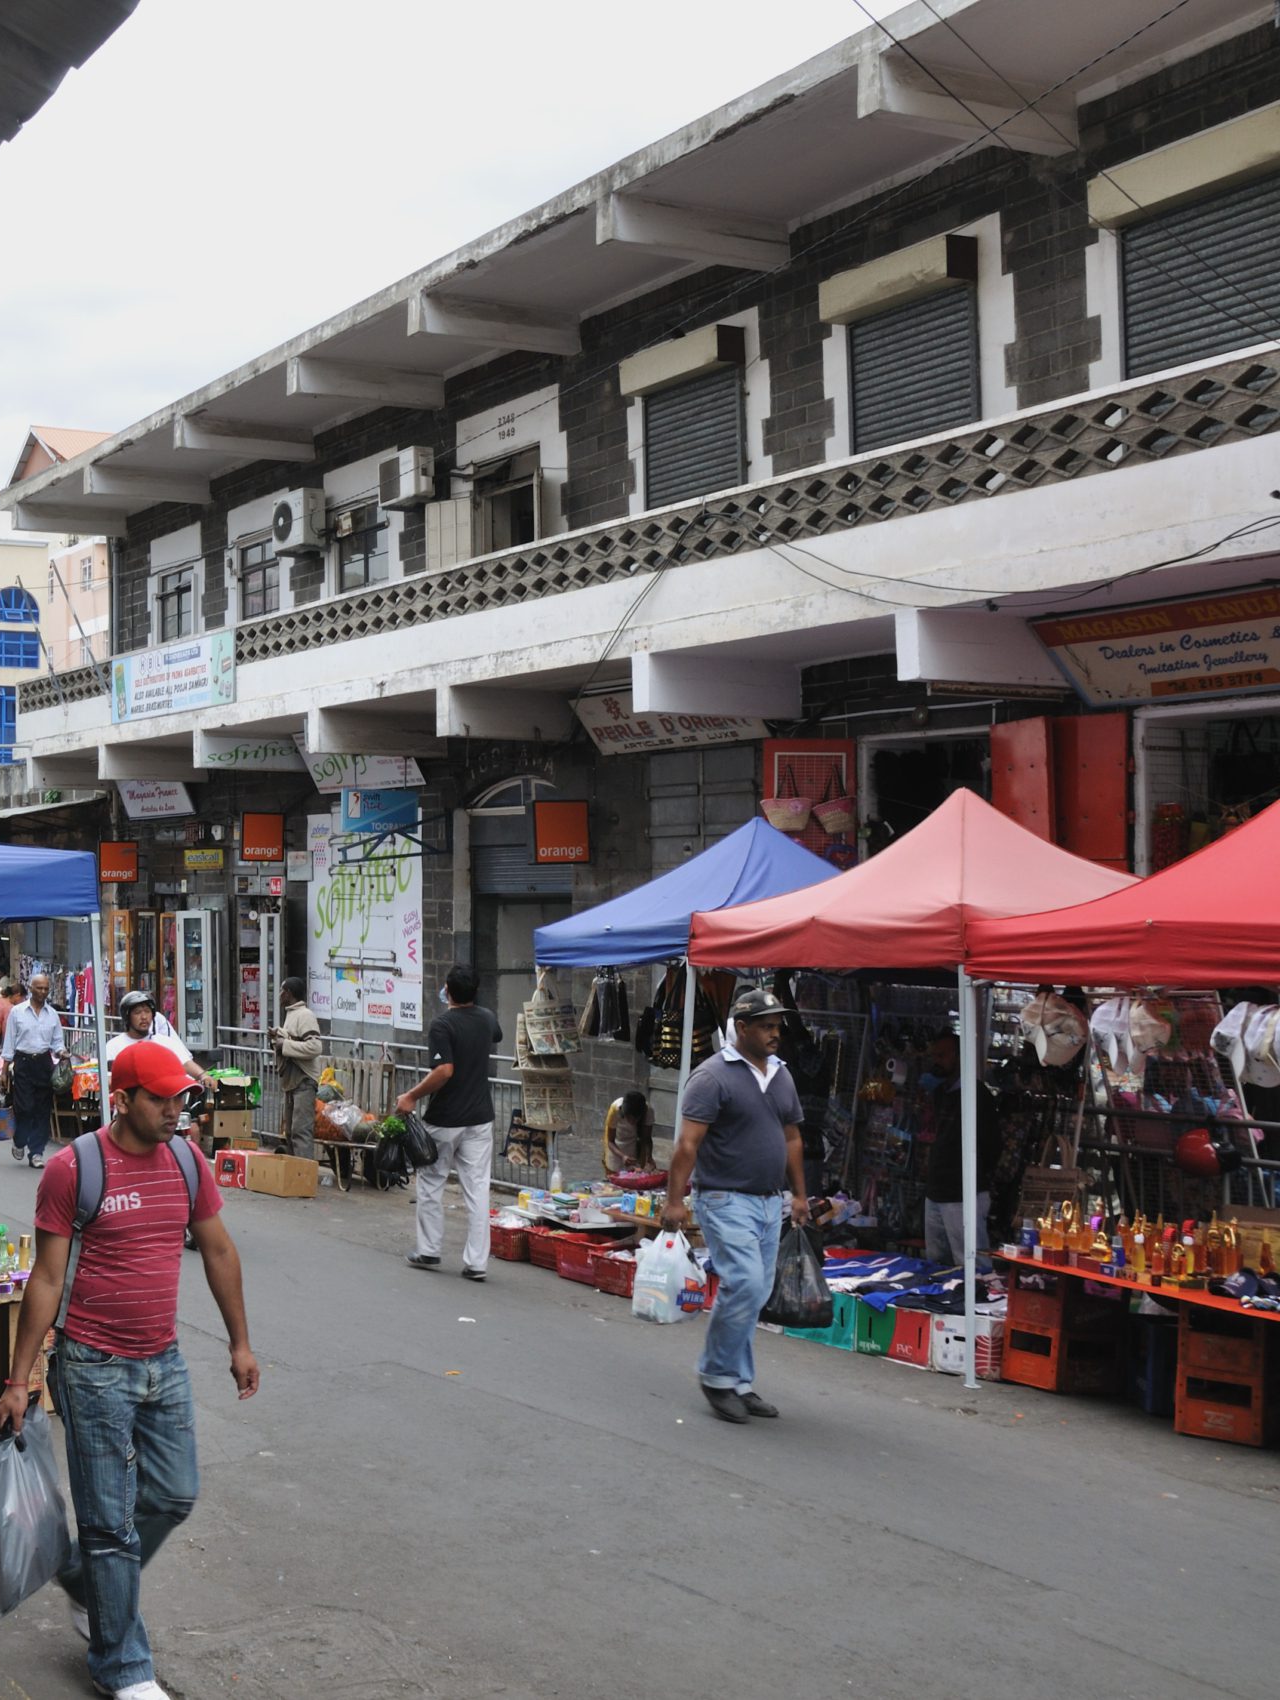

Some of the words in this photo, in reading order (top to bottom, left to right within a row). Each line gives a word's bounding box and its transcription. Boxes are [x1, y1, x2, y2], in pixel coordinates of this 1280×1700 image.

[1056, 612, 1170, 640] MAGASIN
[1187, 594, 1280, 623] TANUJ
[1099, 645, 1155, 660] Dealers
[1160, 642, 1175, 652] in
[1180, 631, 1260, 650] Cosmetics
[1138, 661, 1200, 676] Imitation
[1204, 651, 1268, 671] Jewellery
[145, 686, 165, 699] AVAILABLE
[593, 720, 652, 742] PERLE
[624, 738, 674, 750] ARTICLES
[709, 730, 739, 740] LUXE
[155, 787, 177, 798] France
[245, 847, 278, 857] orange
[540, 844, 583, 859] orange
[102, 870, 132, 879] orange
[312, 992, 330, 1005] Clere
[400, 1002, 416, 1011] BLACK
[102, 1191, 141, 1212] ans
[859, 1341, 881, 1352] apples
